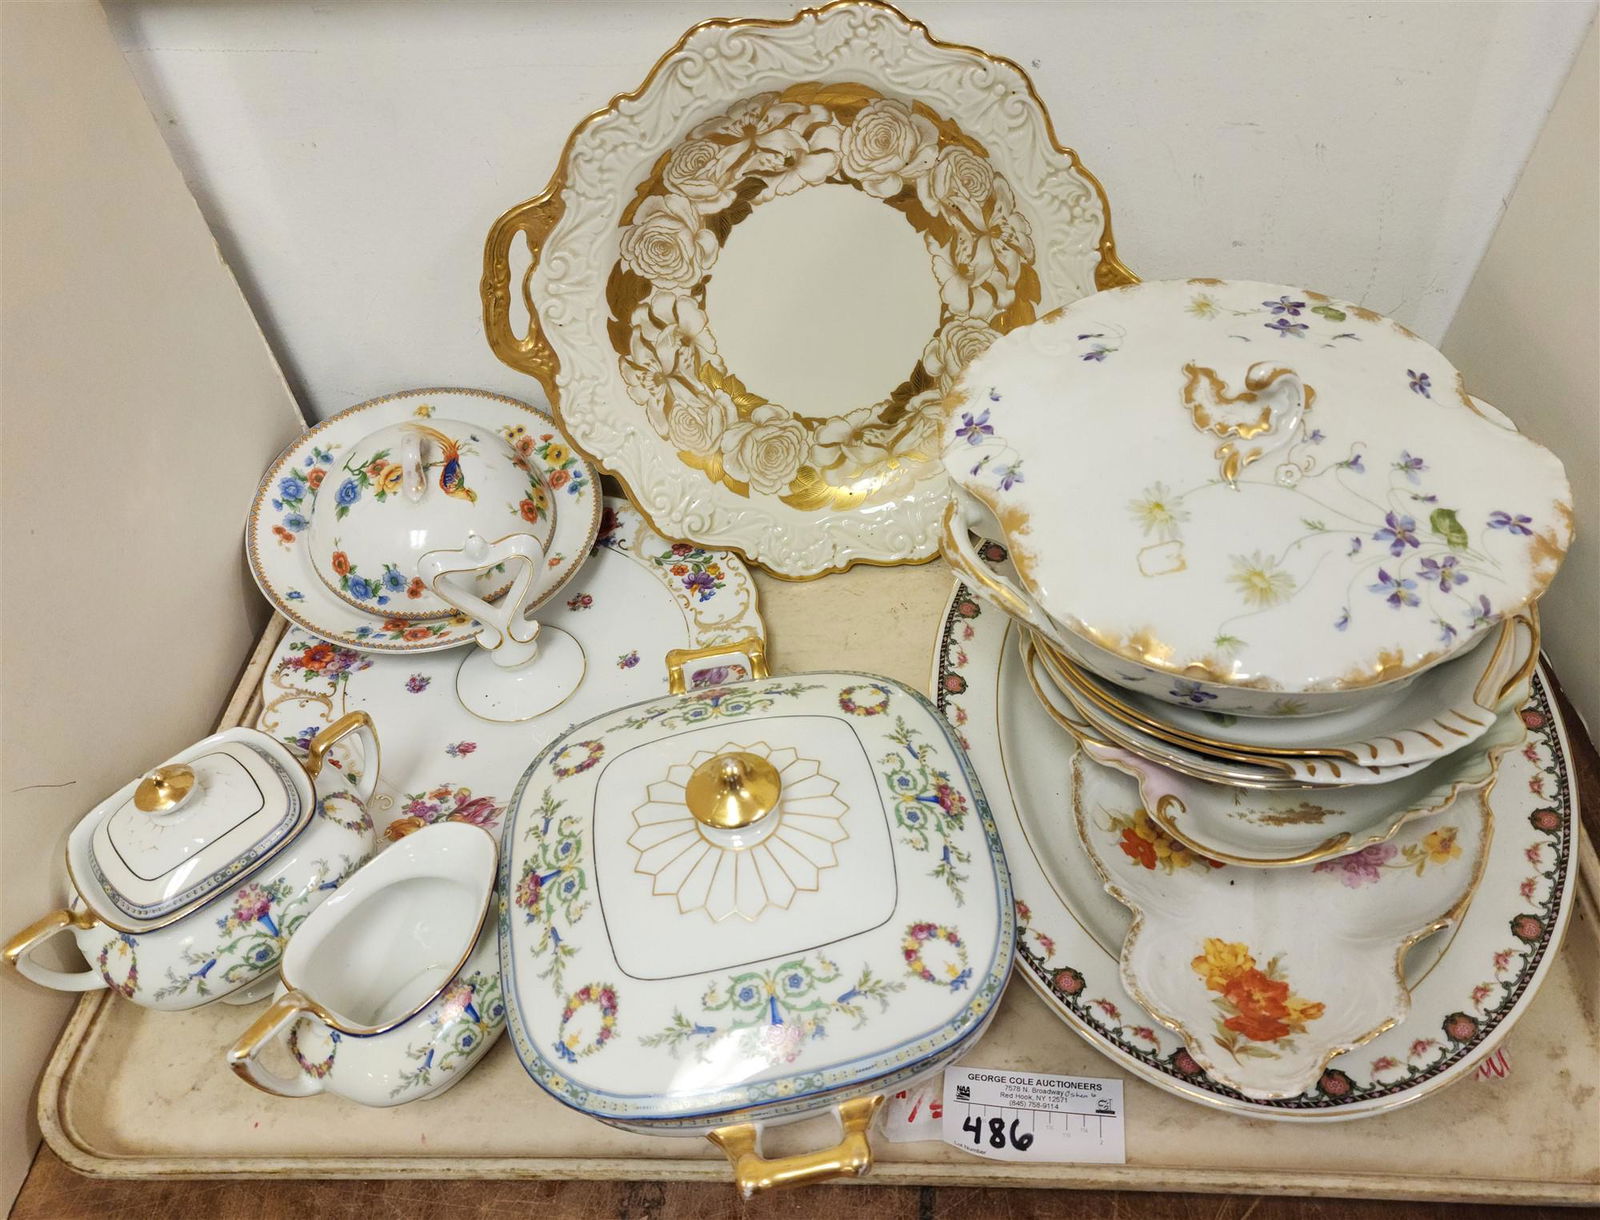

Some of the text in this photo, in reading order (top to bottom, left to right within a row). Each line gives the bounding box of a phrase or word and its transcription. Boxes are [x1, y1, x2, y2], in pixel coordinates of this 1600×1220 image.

[967, 1073, 1103, 1091] GEORGE COLE AUCTIONEERS
[1032, 1087, 1065, 1097] Broadway
[1028, 1102, 1059, 1110] 758-9114
[962, 1116, 1034, 1152] 486
